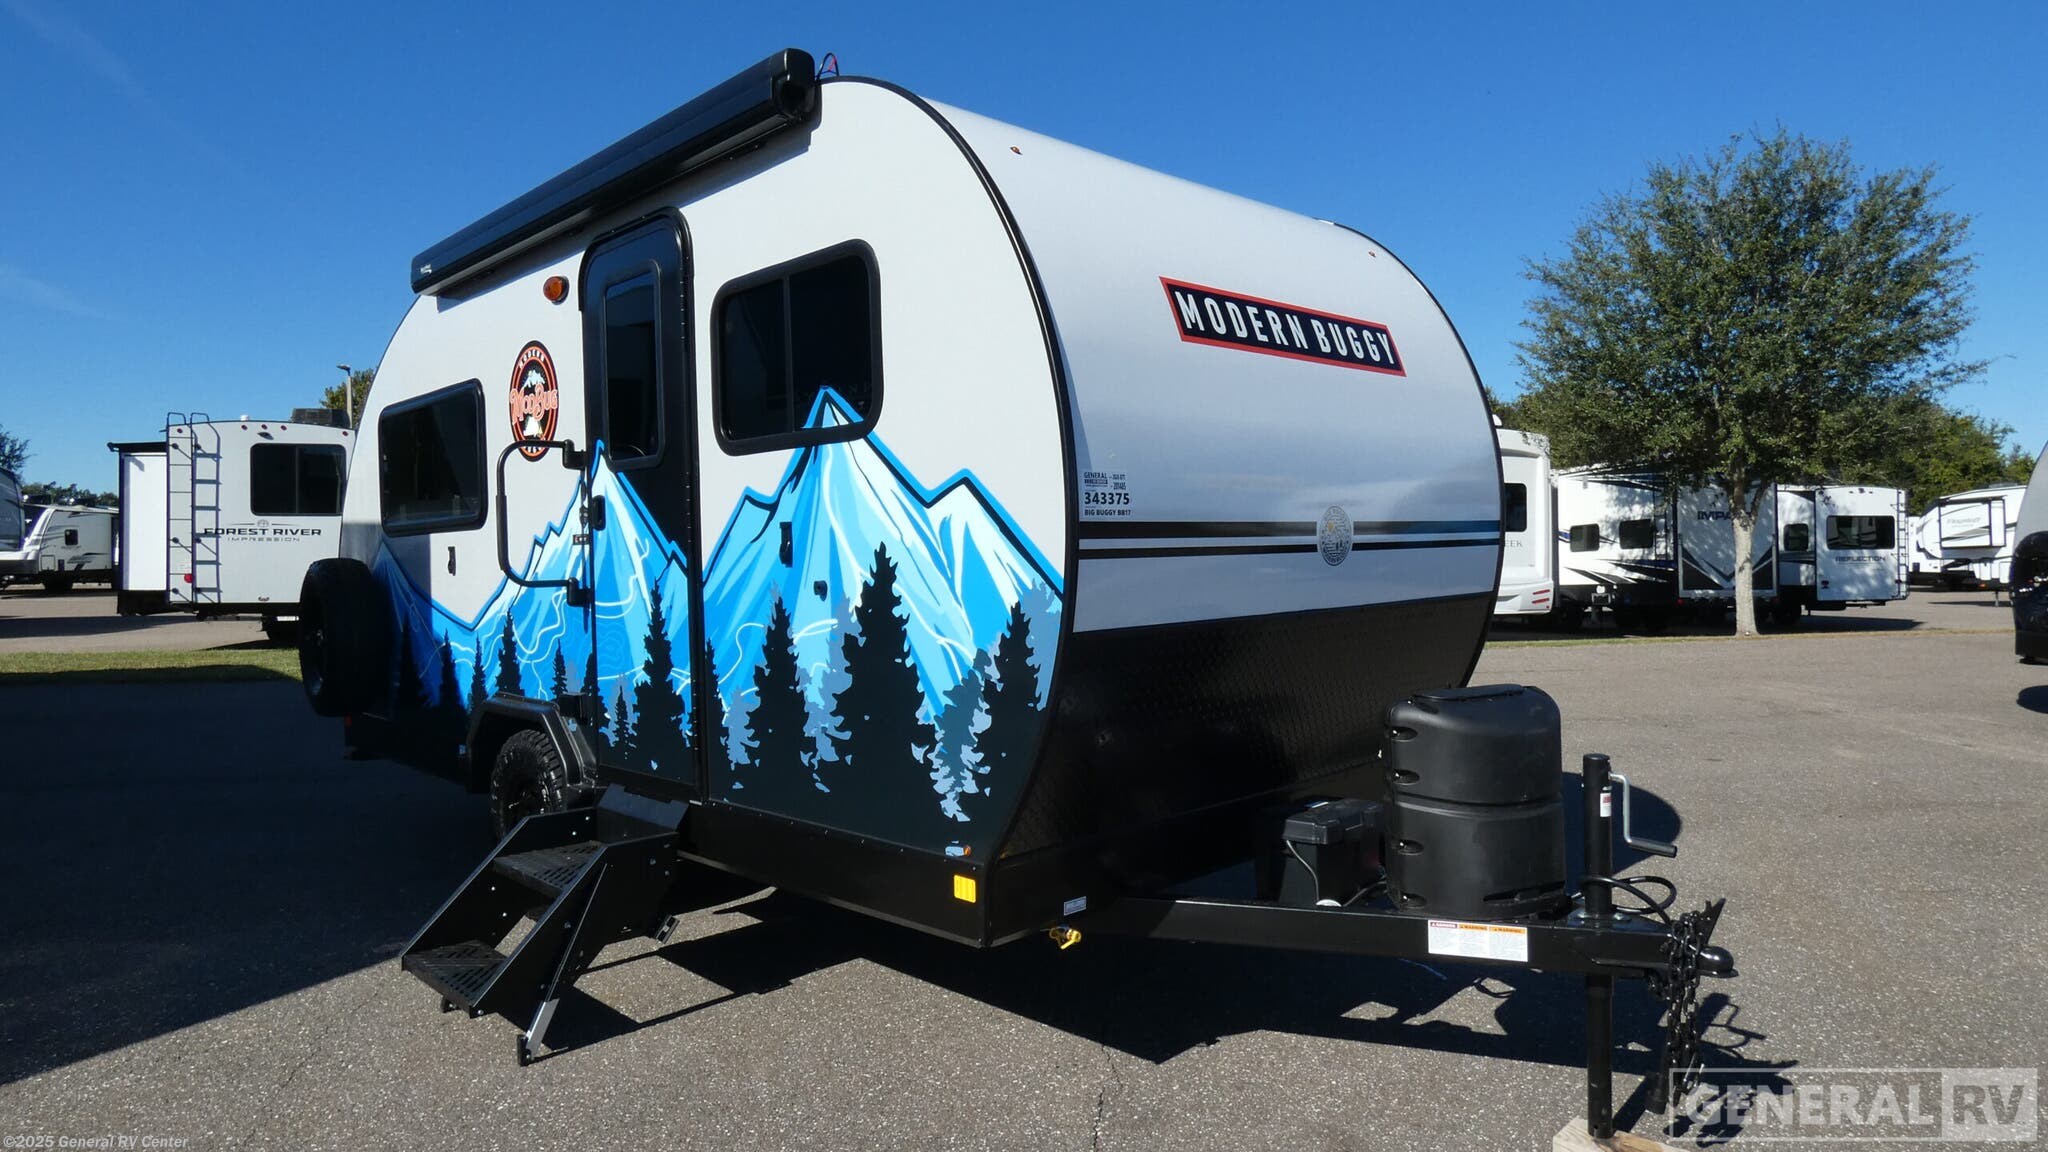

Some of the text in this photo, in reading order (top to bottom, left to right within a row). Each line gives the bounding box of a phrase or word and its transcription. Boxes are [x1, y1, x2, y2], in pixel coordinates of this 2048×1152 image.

[1174, 290, 1395, 365] MODERN BUGGY
[1084, 492, 1129, 504] 343375
[1698, 511, 1752, 521] IMPA
[203, 528, 322, 536] FOREST RIVER
